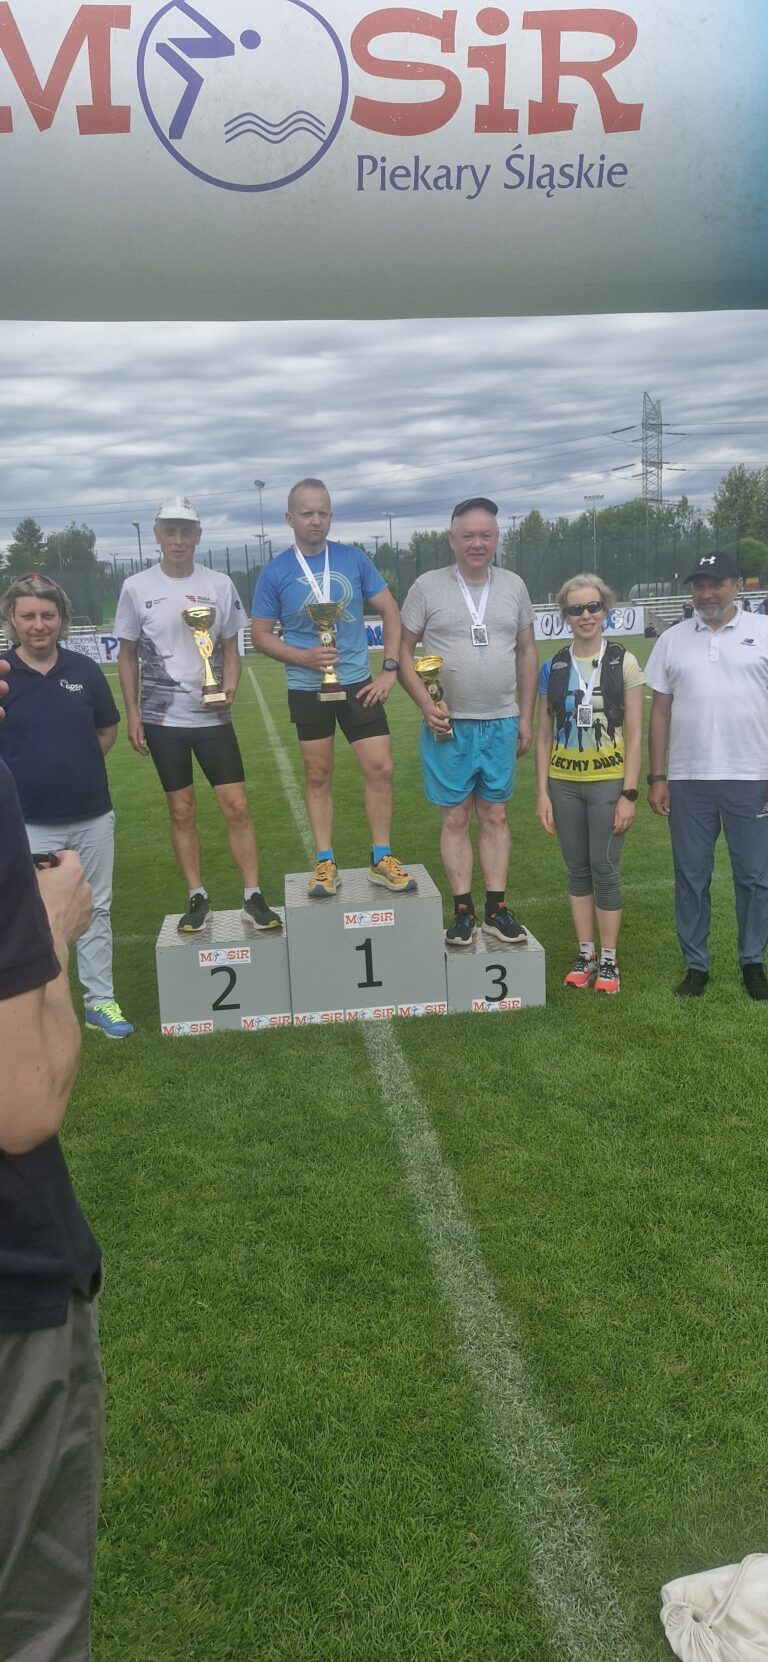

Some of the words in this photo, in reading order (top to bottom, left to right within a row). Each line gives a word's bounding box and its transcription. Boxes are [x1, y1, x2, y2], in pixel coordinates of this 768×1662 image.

[356, 154, 491, 200] Piekary
[503, 143, 628, 198] Śląskie
[551, 755, 589, 772] LECYMY
[355, 938, 383, 988] 1
[485, 964, 508, 1002] 3
[211, 965, 241, 1011] 2
